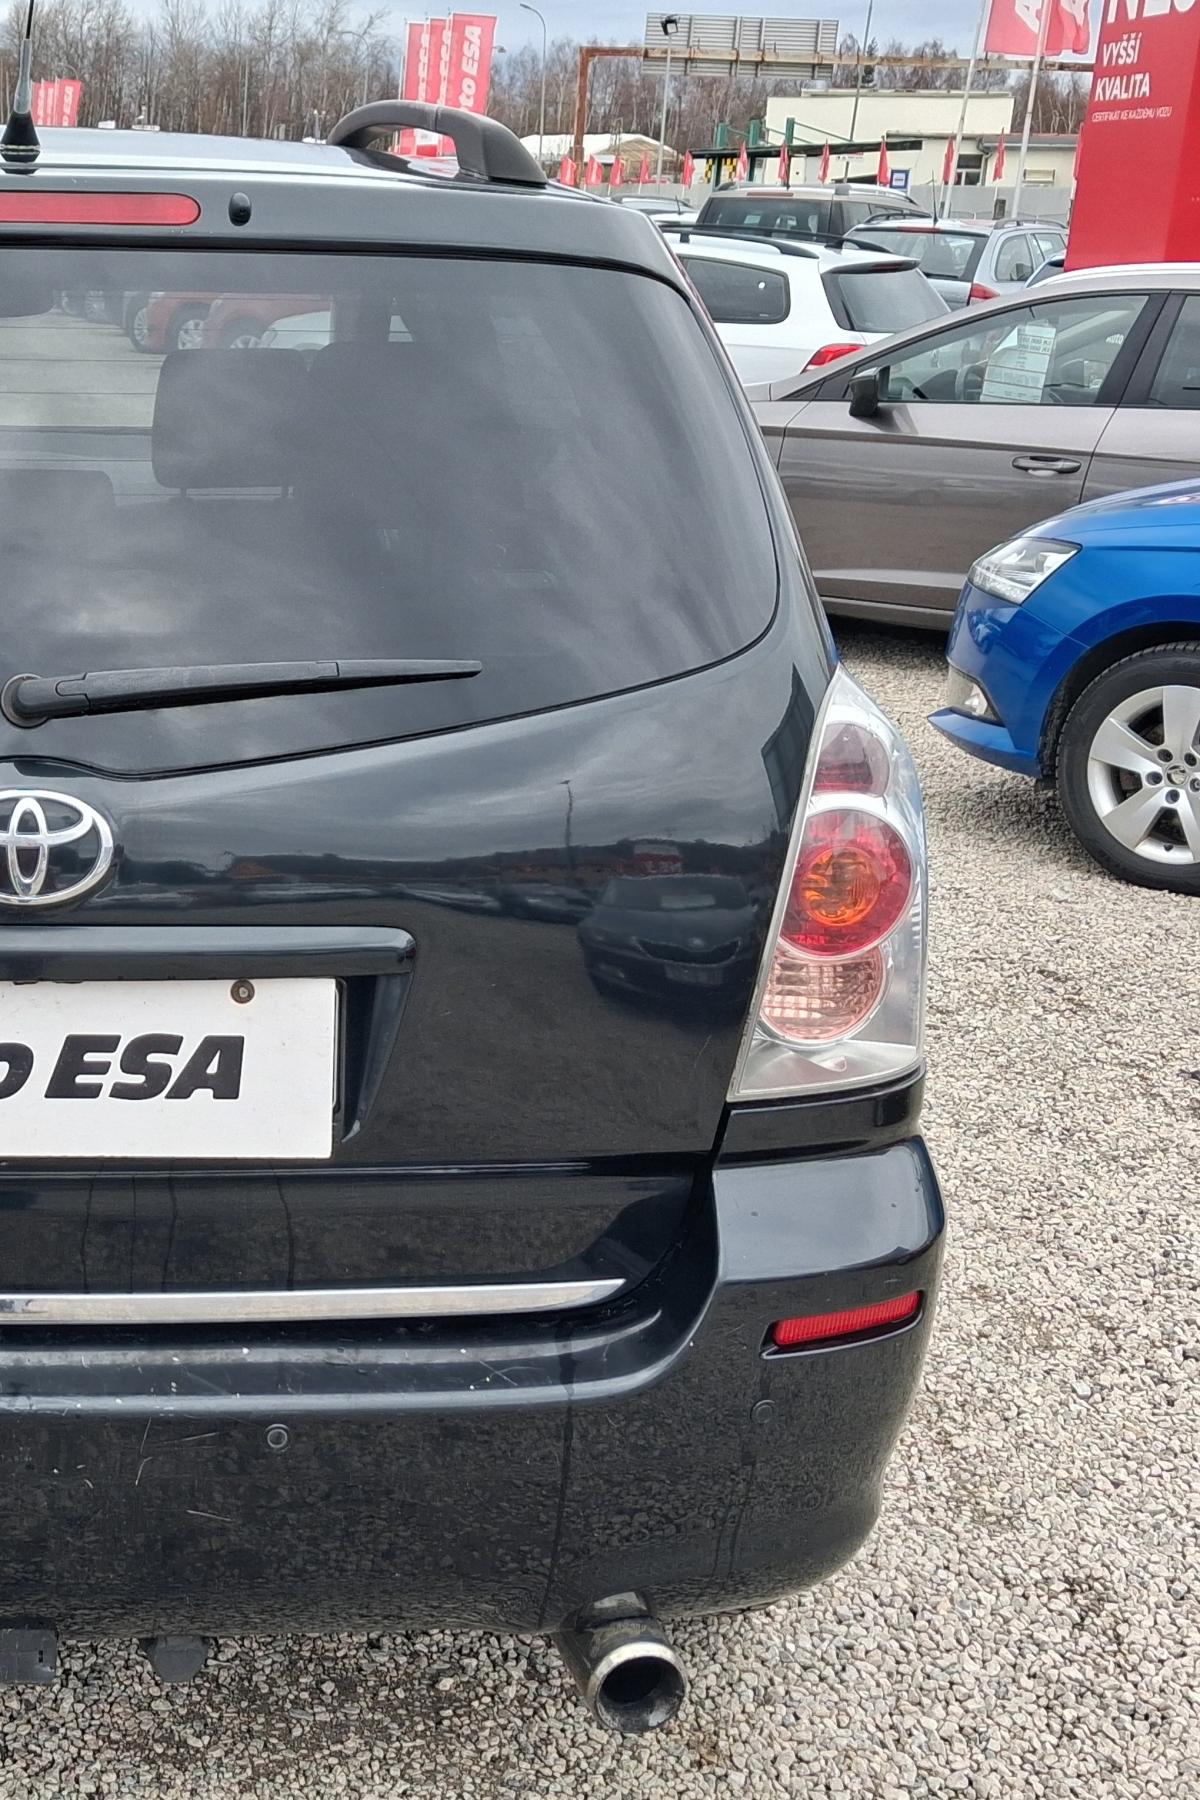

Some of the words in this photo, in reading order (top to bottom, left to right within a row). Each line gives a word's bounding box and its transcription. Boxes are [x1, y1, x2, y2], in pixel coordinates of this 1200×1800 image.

[461, 25, 482, 77] ESA
[1103, 32, 1142, 67] VYŠŠÍ
[458, 77, 476, 111] to
[1095, 72, 1150, 102] KVALITA
[45, 1034, 245, 1101] ESA
